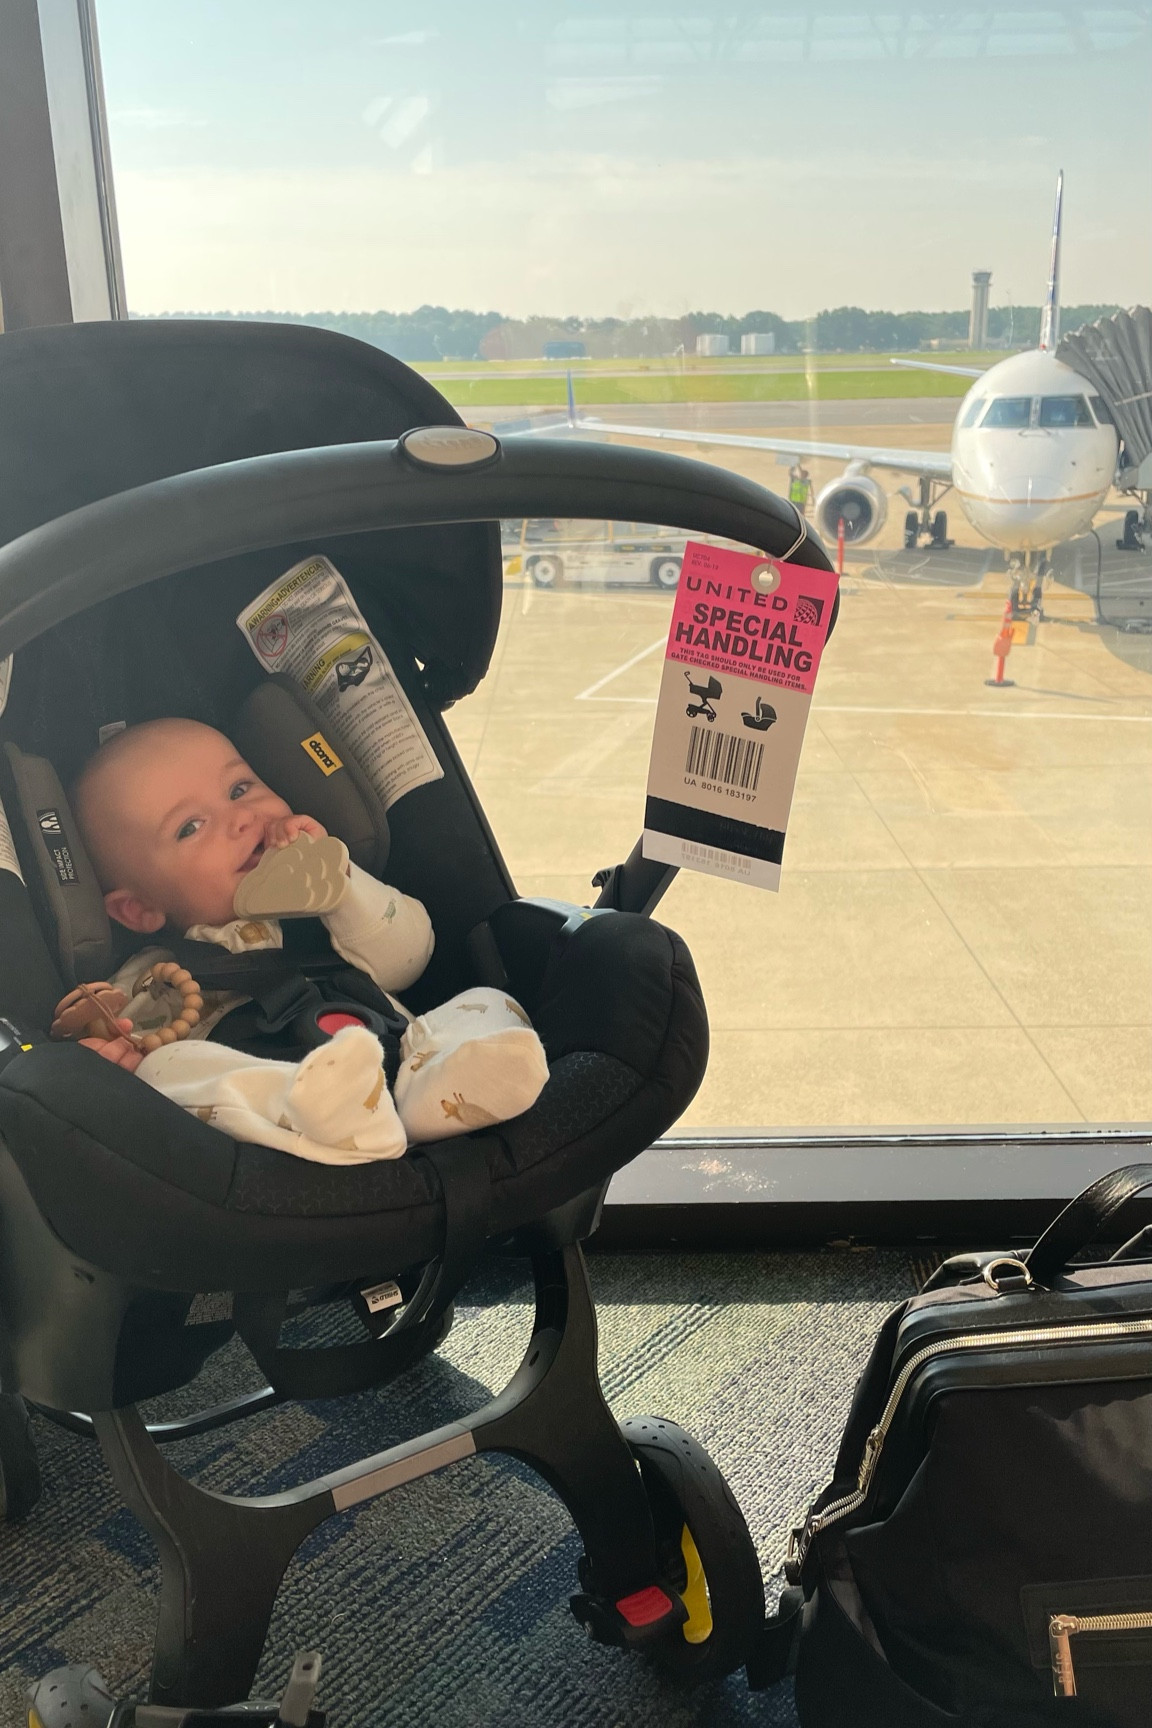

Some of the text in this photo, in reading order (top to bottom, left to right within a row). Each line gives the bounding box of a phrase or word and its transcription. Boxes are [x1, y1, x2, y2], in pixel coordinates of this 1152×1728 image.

[253, 598, 279, 625] WARNING
[278, 563, 323, 600] ADVERTENCIA
[686, 576, 788, 611] UNITED
[693, 602, 803, 647] SPECIAL
[675, 622, 813, 672] HANDLING
[680, 647, 695, 656] THIS
[696, 652, 709, 660] TAG
[711, 655, 737, 667] SHOULD
[738, 662, 757, 671] ONLY
[768, 669, 786, 679] USED
[787, 673, 801, 682] FOR
[671, 652, 807, 690] GATE CHECKED SPECIAL HANDLING ITEMS.
[308, 739, 334, 768] doona
[684, 776, 757, 802] UA 8016 183197
